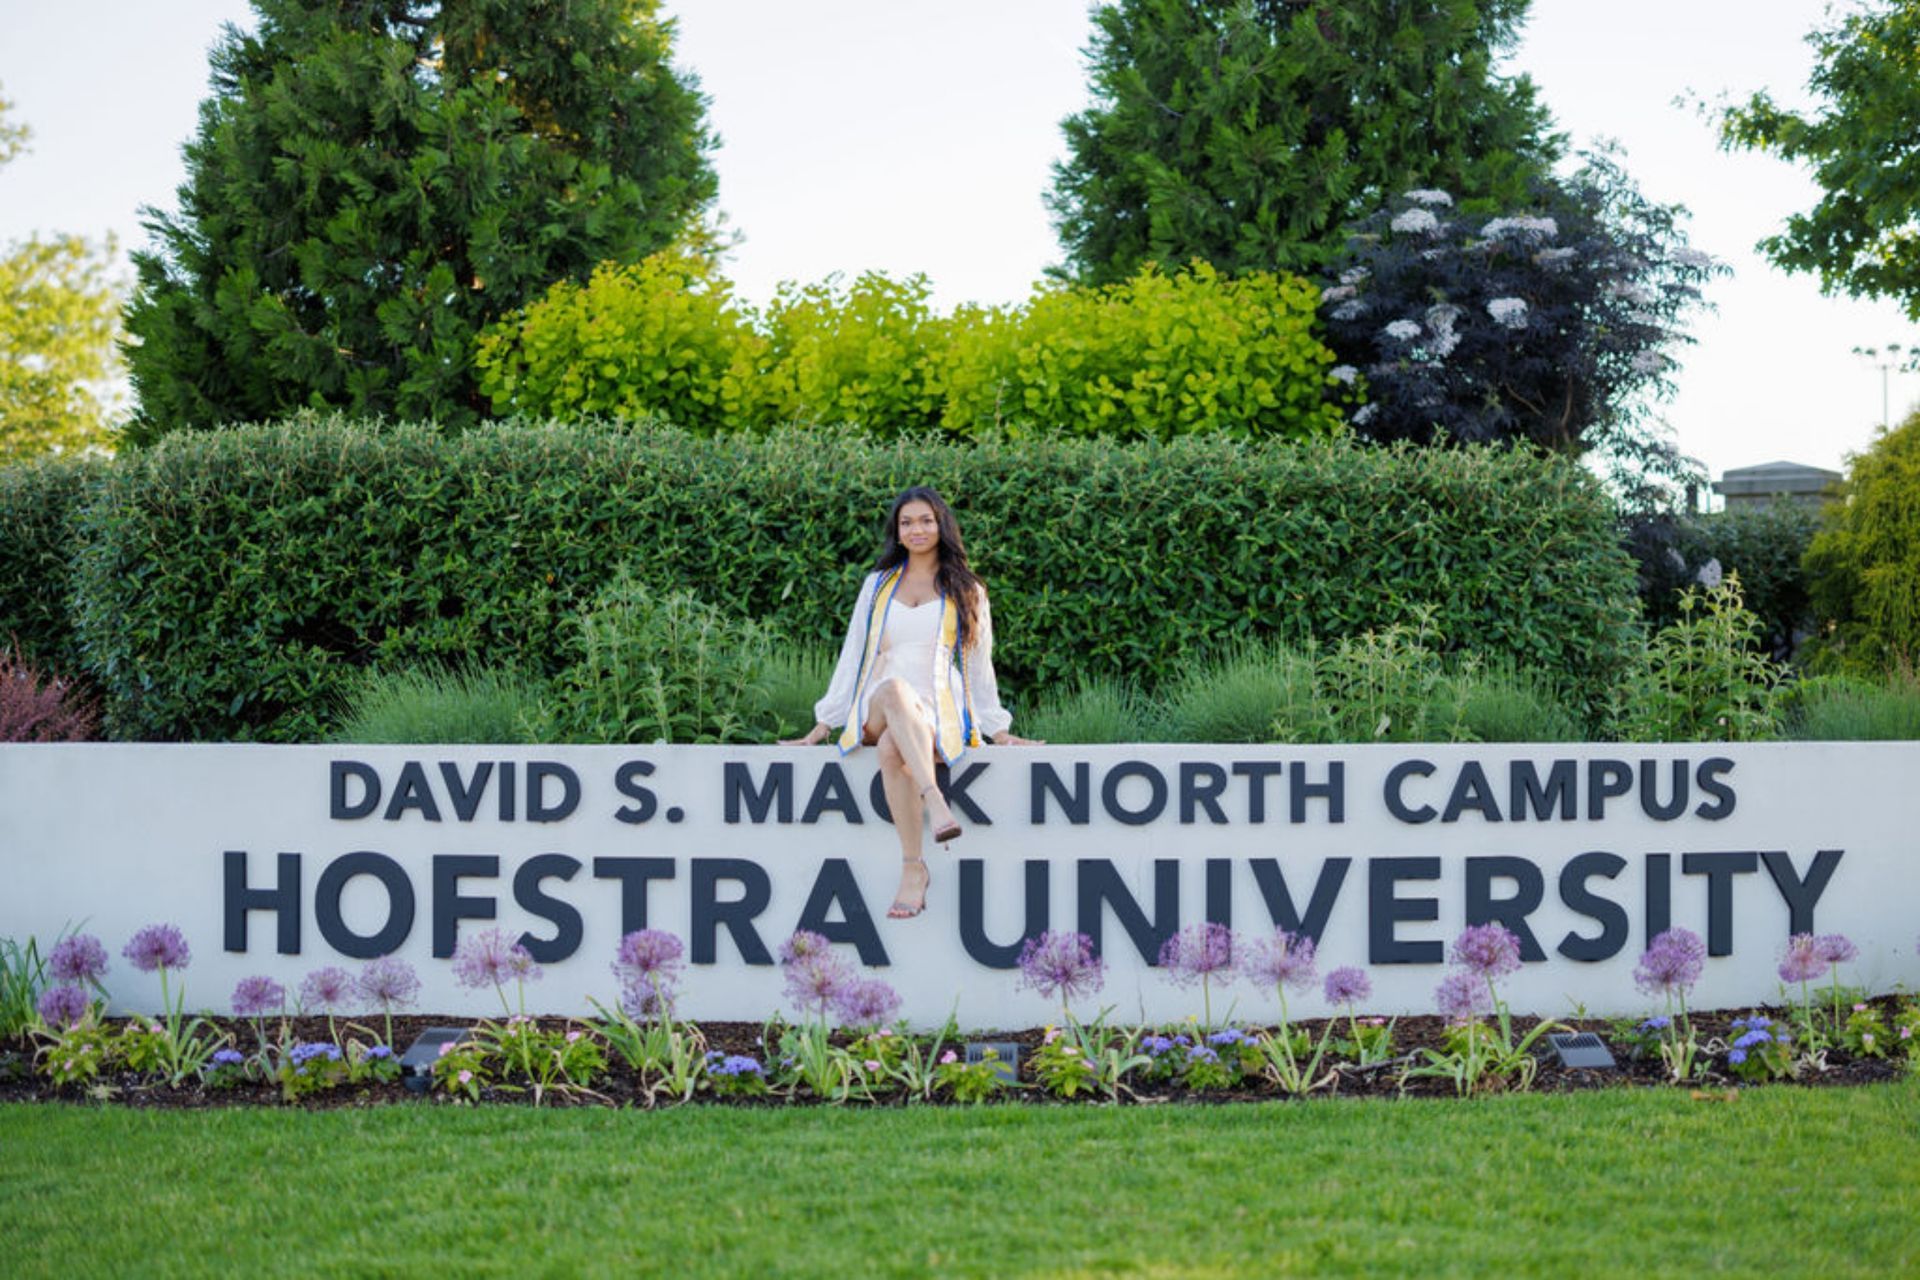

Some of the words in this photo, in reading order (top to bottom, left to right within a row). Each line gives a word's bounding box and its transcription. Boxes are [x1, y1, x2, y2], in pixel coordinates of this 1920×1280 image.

[330, 760, 582, 824] DAVID
[614, 760, 685, 824] S.
[1030, 760, 1345, 825] NORTH
[1383, 757, 1737, 824] CAMPUS
[223, 851, 891, 968] HOFSTRA
[958, 850, 1845, 969] UNIVERSITY
